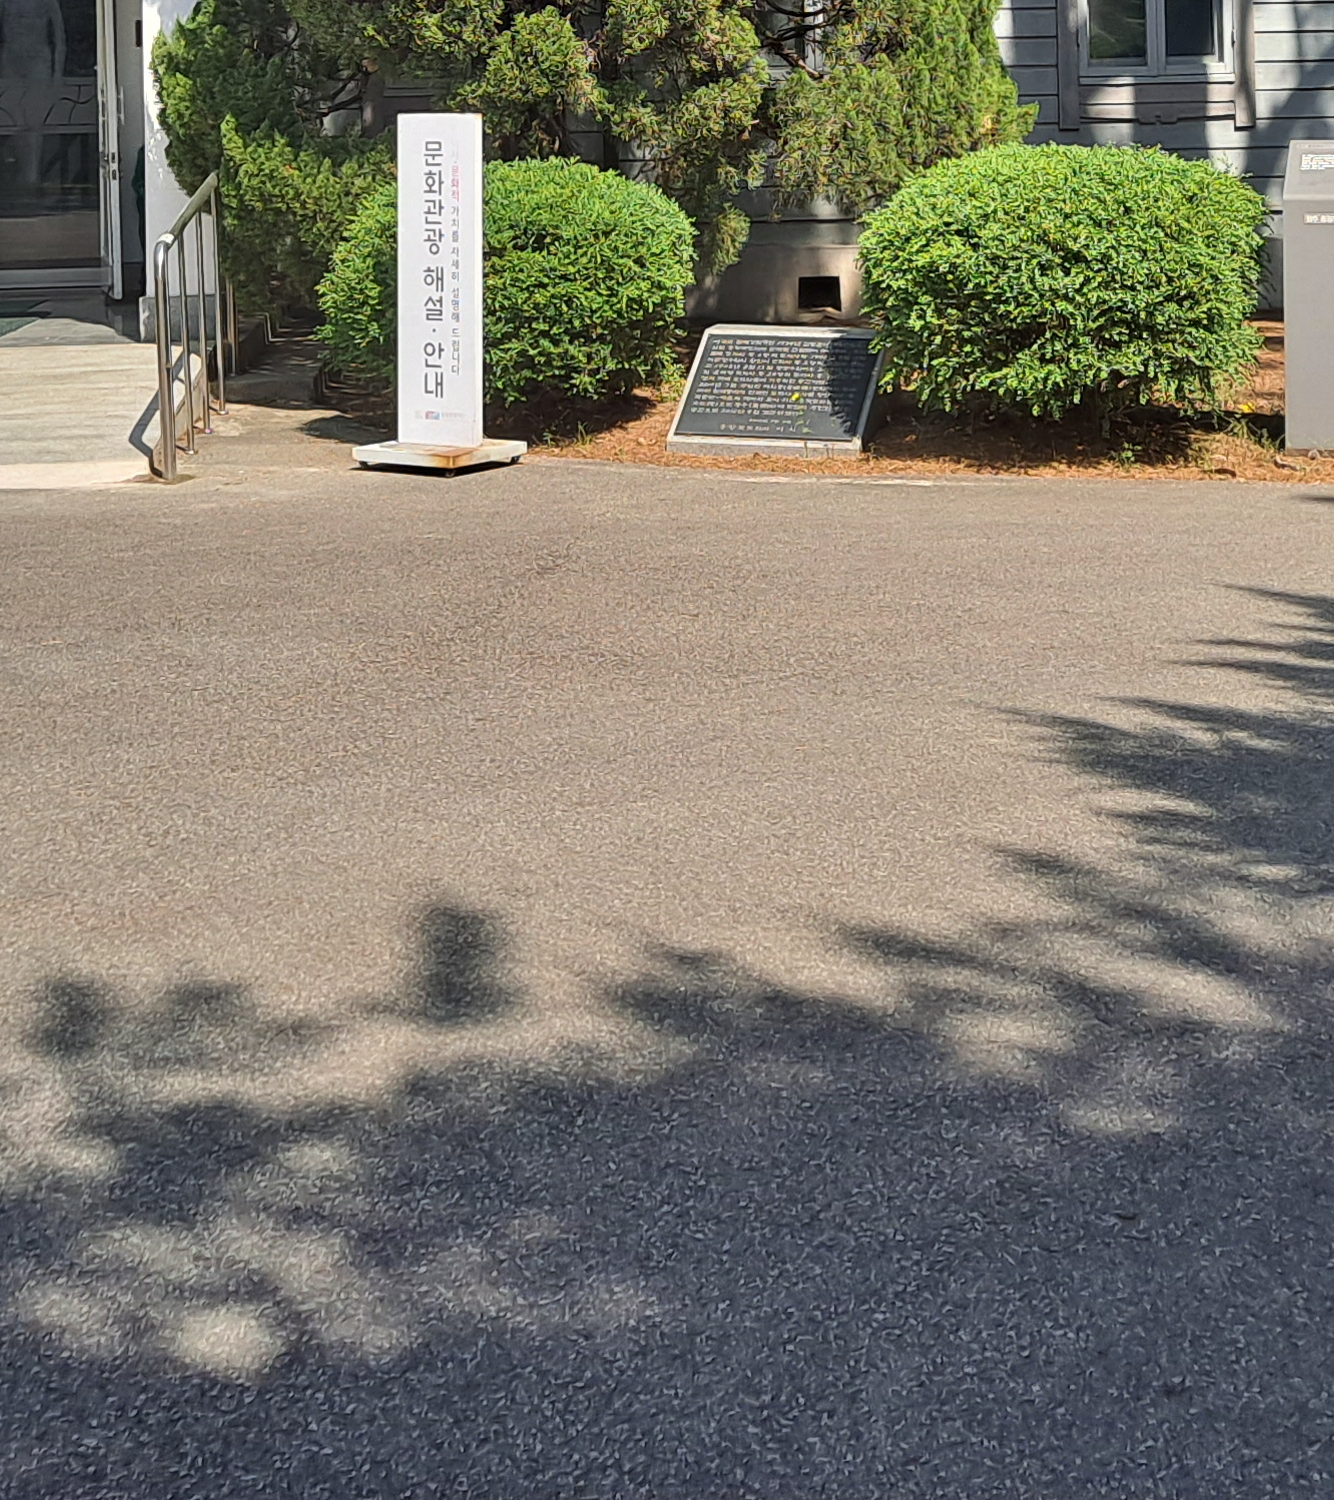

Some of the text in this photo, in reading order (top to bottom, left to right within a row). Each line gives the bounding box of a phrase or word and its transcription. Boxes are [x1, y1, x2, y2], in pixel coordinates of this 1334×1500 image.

[451, 206, 460, 243] 가치를
[423, 140, 445, 399] 문화관광 해설·안내
[451, 246, 460, 282] 자세히
[451, 287, 460, 323] 설명해
[451, 327, 461, 376] 드립니다
